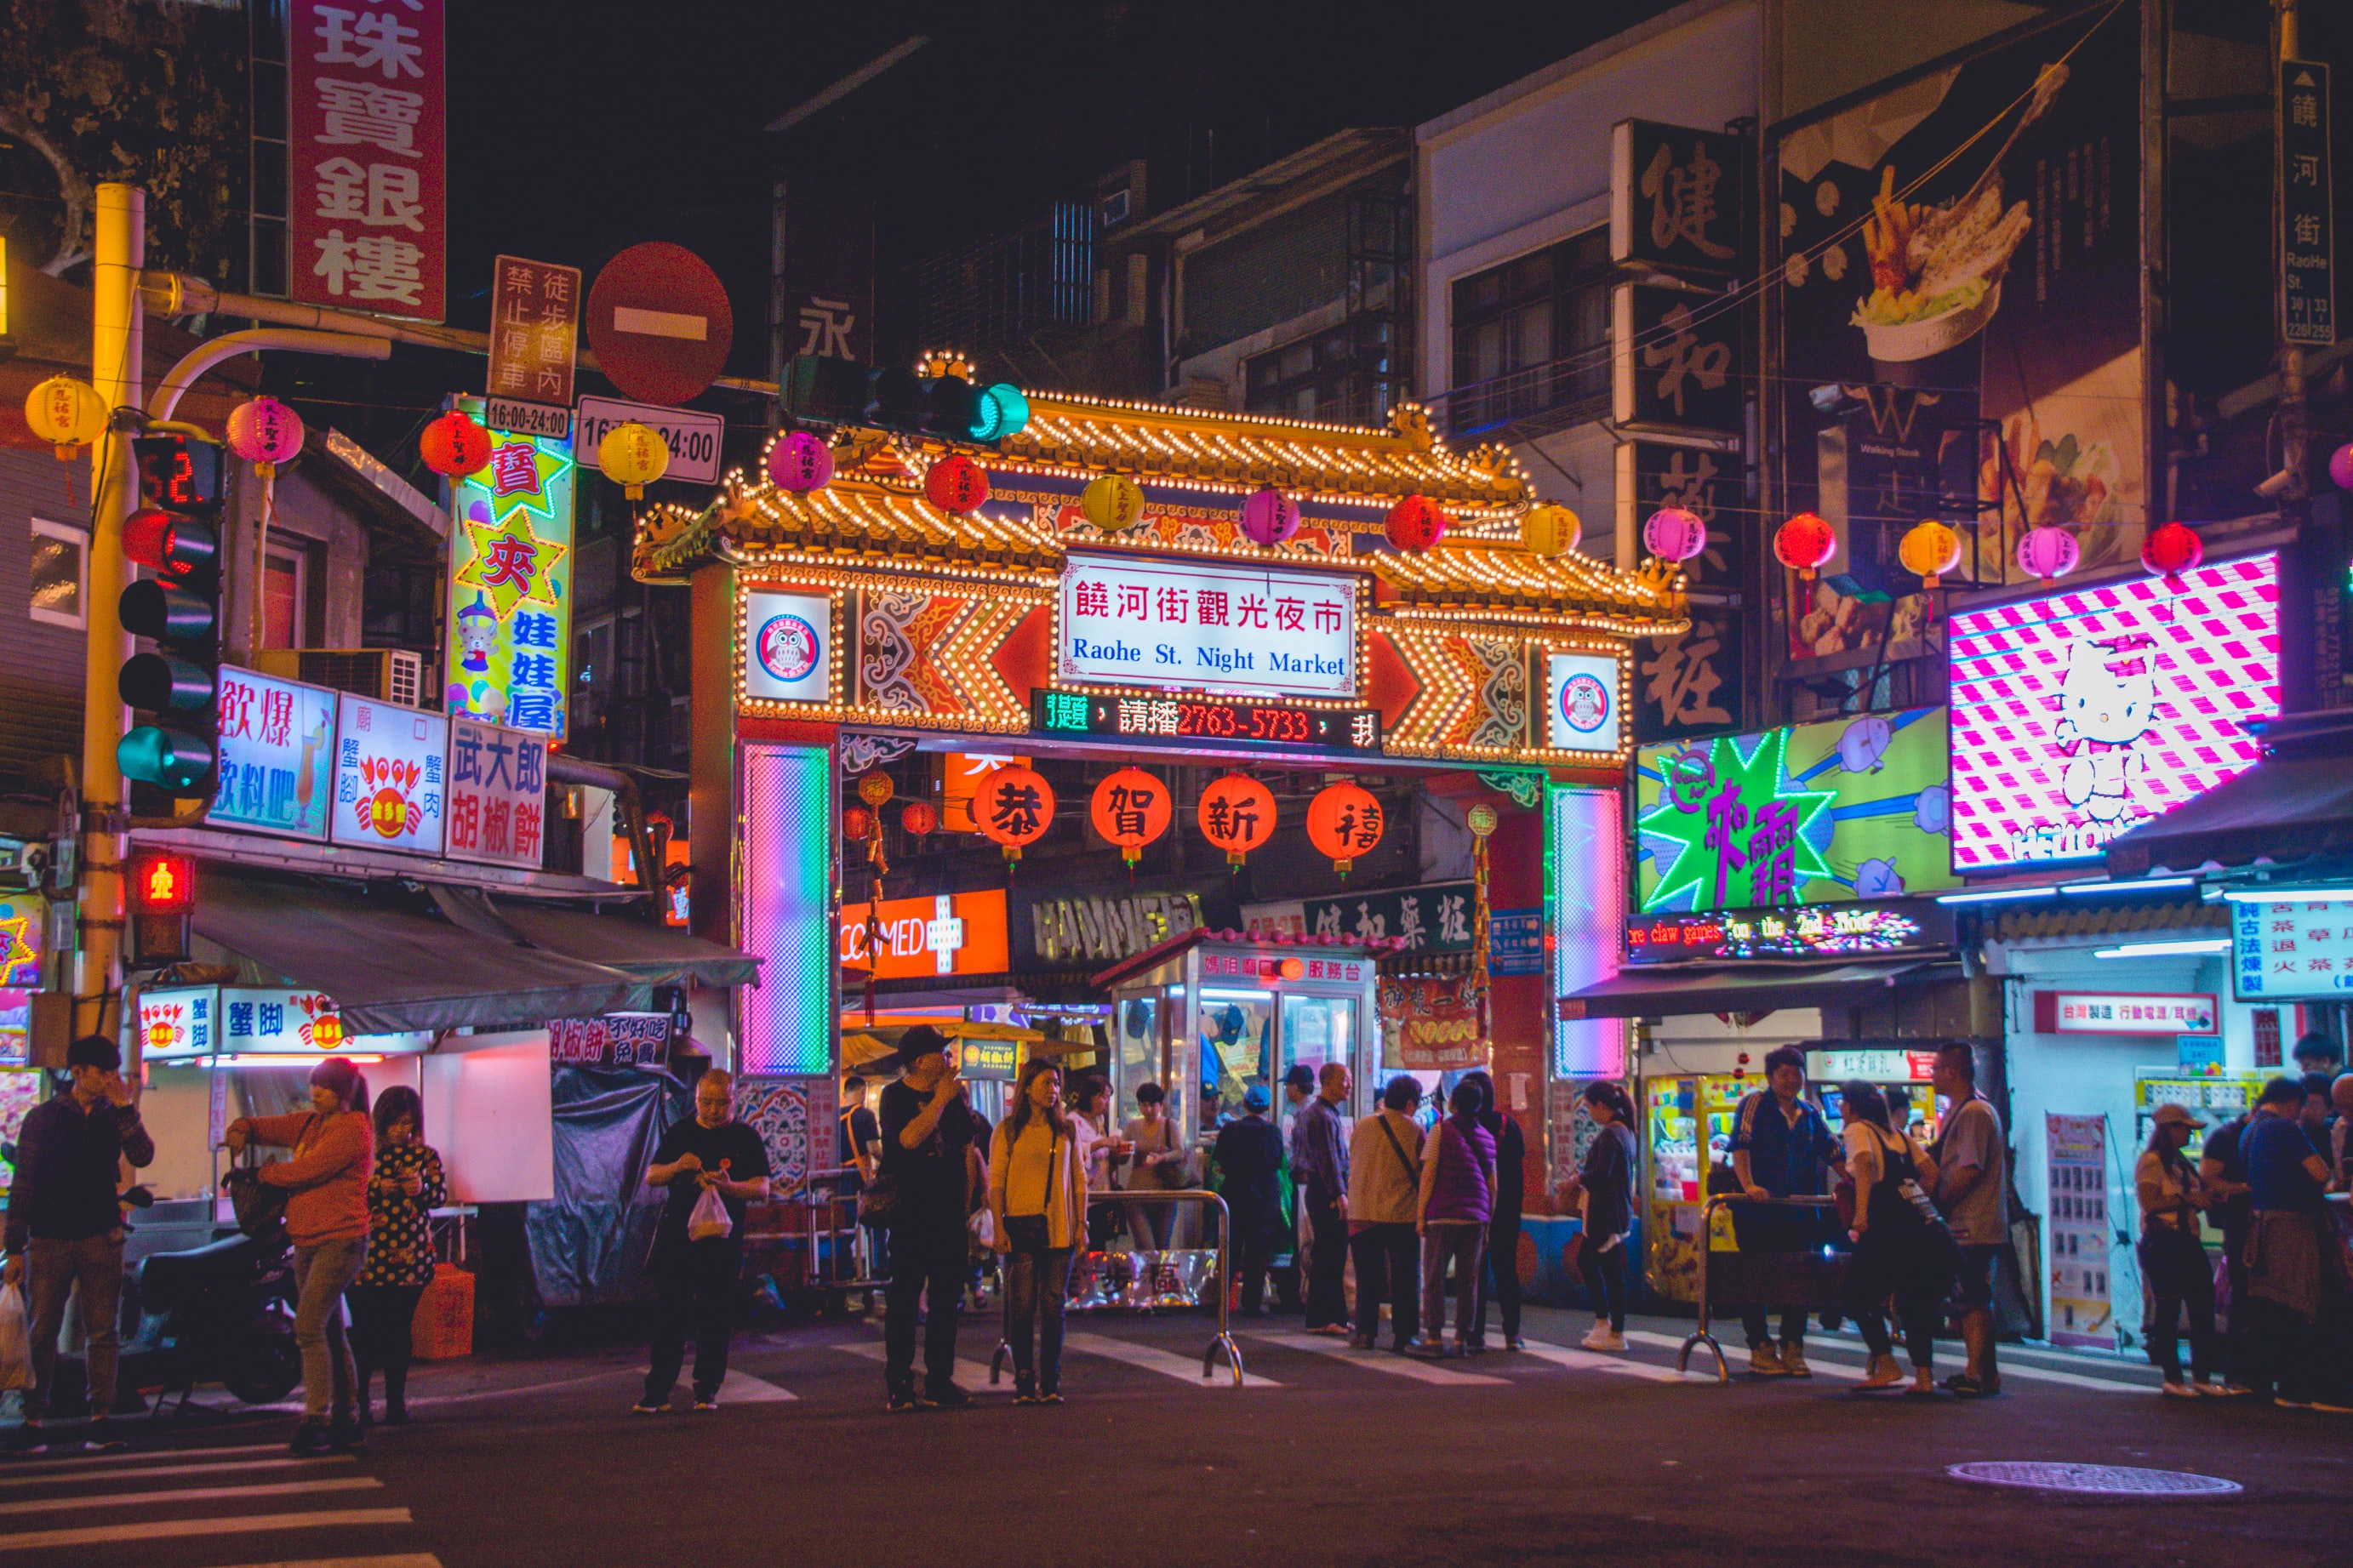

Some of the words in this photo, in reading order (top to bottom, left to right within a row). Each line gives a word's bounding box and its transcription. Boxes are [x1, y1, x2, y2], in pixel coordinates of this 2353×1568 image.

[312, 0, 425, 306] 珠寶銀樓
[2291, 94, 2321, 246] 饒河街
[2287, 252, 2328, 270] RaoHe
[2287, 274, 2304, 291] St.
[500, 265, 534, 390] 禁止停車
[537, 271, 569, 396] 徒步區內
[798, 294, 857, 362] 永
[491, 402, 566, 435] 16:00-24:00
[1859, 443, 1895, 458] Walking
[1075, 579, 1344, 636] 饒河街觀光夜市
[1072, 637, 1142, 664] Raohe
[1154, 642, 1183, 667] St.
[1196, 646, 1254, 675] Night
[1268, 652, 1345, 676] Market
[423, 754, 443, 819] 蟹肉
[453, 727, 543, 795] 武大郎
[451, 789, 540, 859] 胡椒餅
[991, 782, 1043, 836] 恭
[1108, 784, 1153, 838] 賀
[1207, 795, 1259, 843] 新
[1334, 802, 1384, 849] 禧
[1316, 892, 1471, 950] 健和藥粧
[1650, 922, 1681, 944] claw
[1682, 921, 1722, 948] games
[1760, 916, 1785, 938] the
[1796, 913, 1824, 937] 2nd
[2238, 902, 2264, 993] 純古法煉製
[1308, 960, 1362, 982] 服務台
[609, 1018, 667, 1041] 不好吃
[2063, 1003, 2113, 1020] 台灣製造
[614, 1041, 656, 1064] 免費
[979, 1050, 1015, 1065] 胡椒餅
